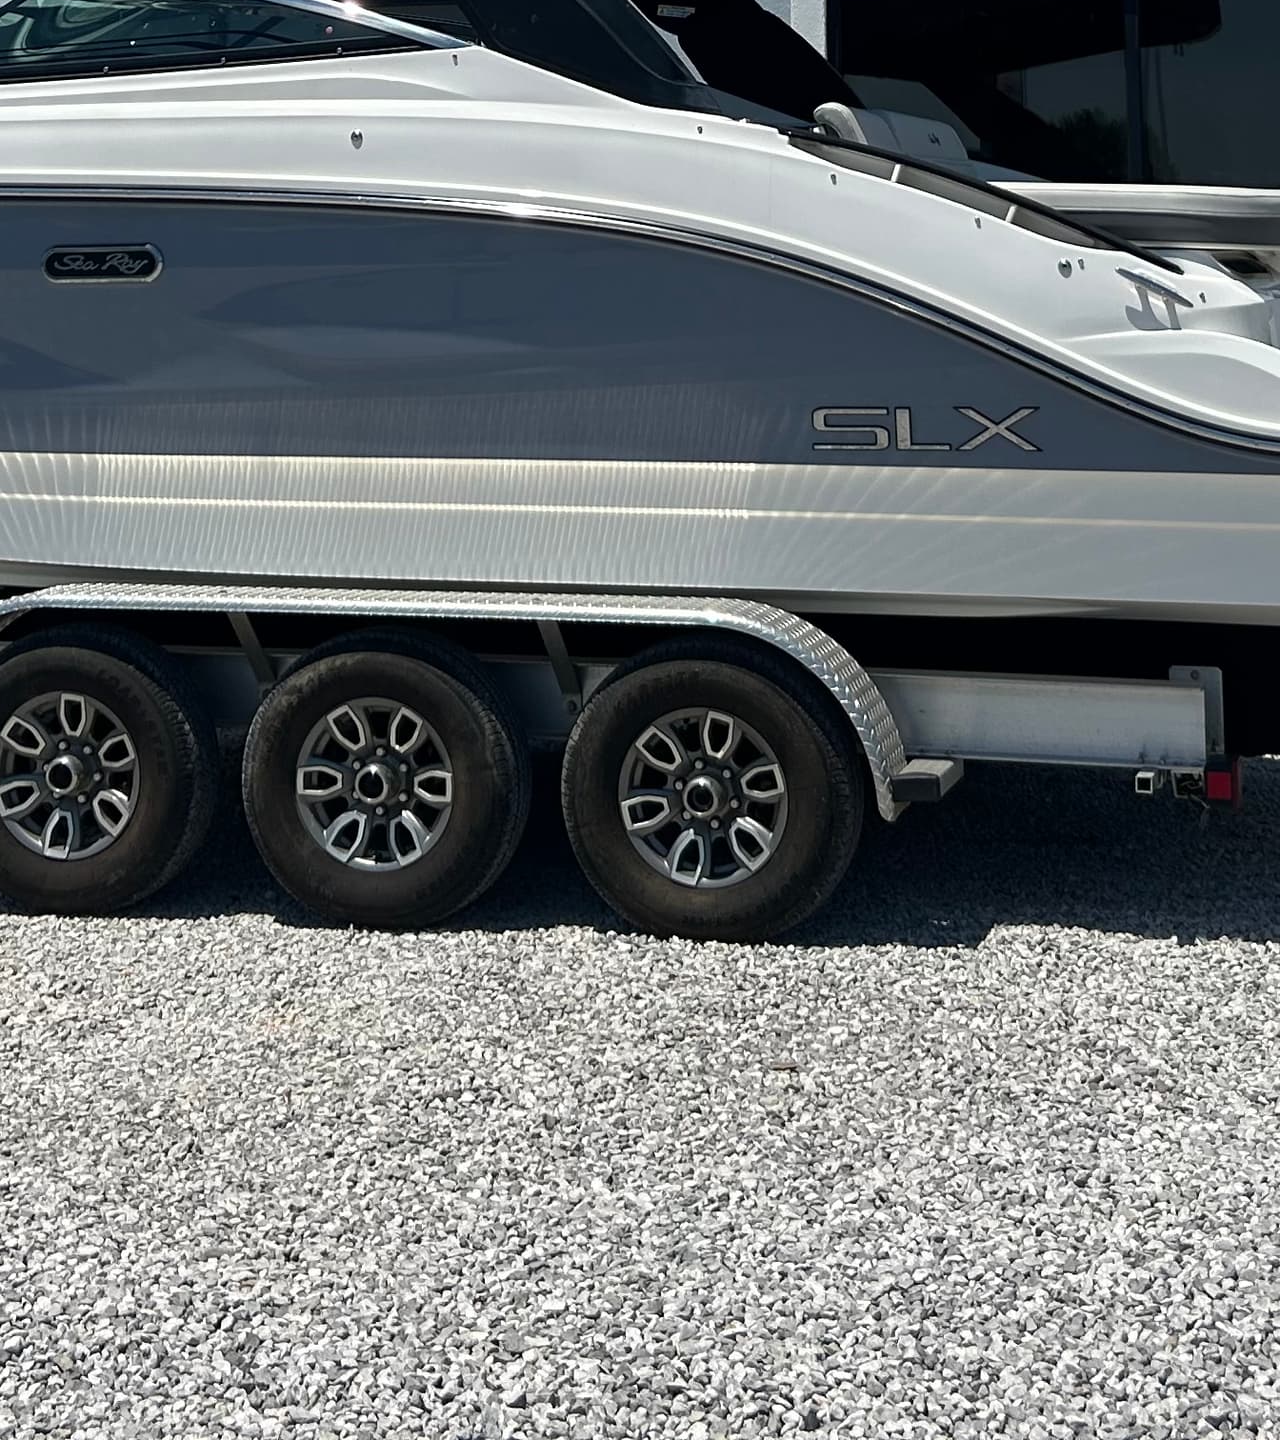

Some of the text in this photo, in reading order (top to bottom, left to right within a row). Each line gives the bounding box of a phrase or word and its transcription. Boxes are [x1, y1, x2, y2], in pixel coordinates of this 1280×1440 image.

[53, 252, 149, 275] Sea Ray
[811, 406, 1044, 452] SLX
